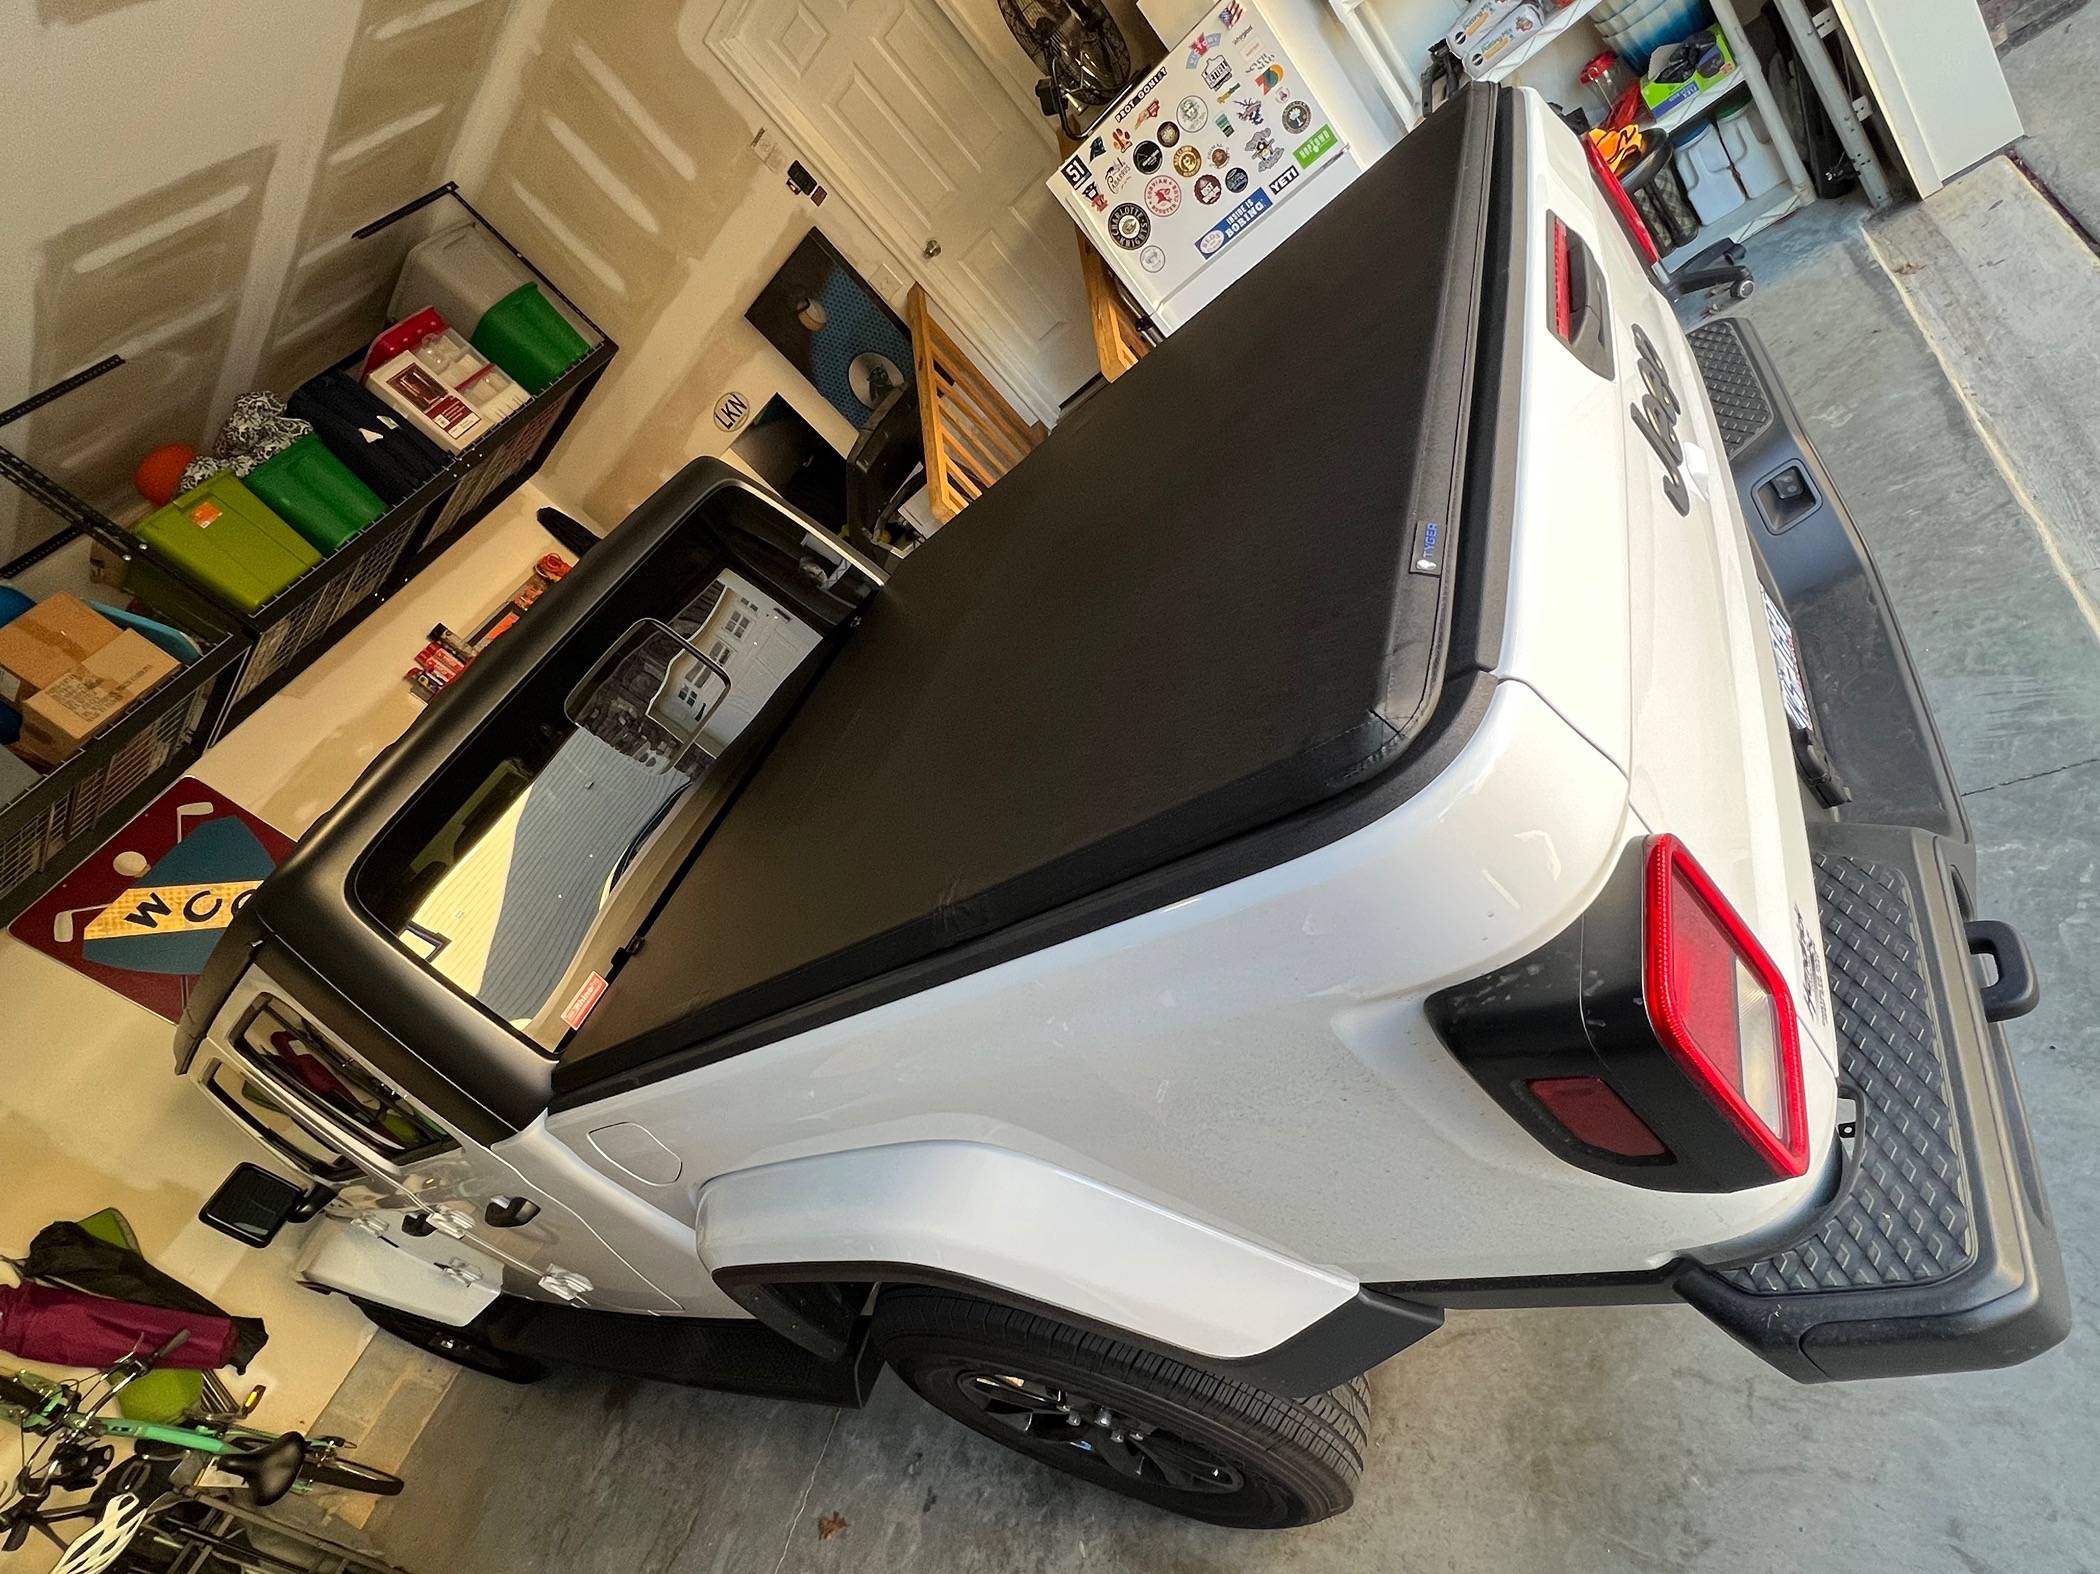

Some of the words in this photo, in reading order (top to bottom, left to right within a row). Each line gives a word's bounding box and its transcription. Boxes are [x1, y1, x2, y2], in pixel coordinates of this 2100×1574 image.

[1065, 160, 1085, 182] 51
[1271, 169, 1298, 192] YETI
[1111, 206, 1144, 236] CHARLOTTE
[1224, 200, 1264, 238] BORING
[1226, 204, 1247, 226] INSIDE
[1244, 199, 1254, 210] IS
[1118, 221, 1148, 247] KNIGHTS
[715, 394, 748, 430] LKN
[1630, 323, 1690, 517] Jeep
[1423, 522, 1438, 559] TYGER
